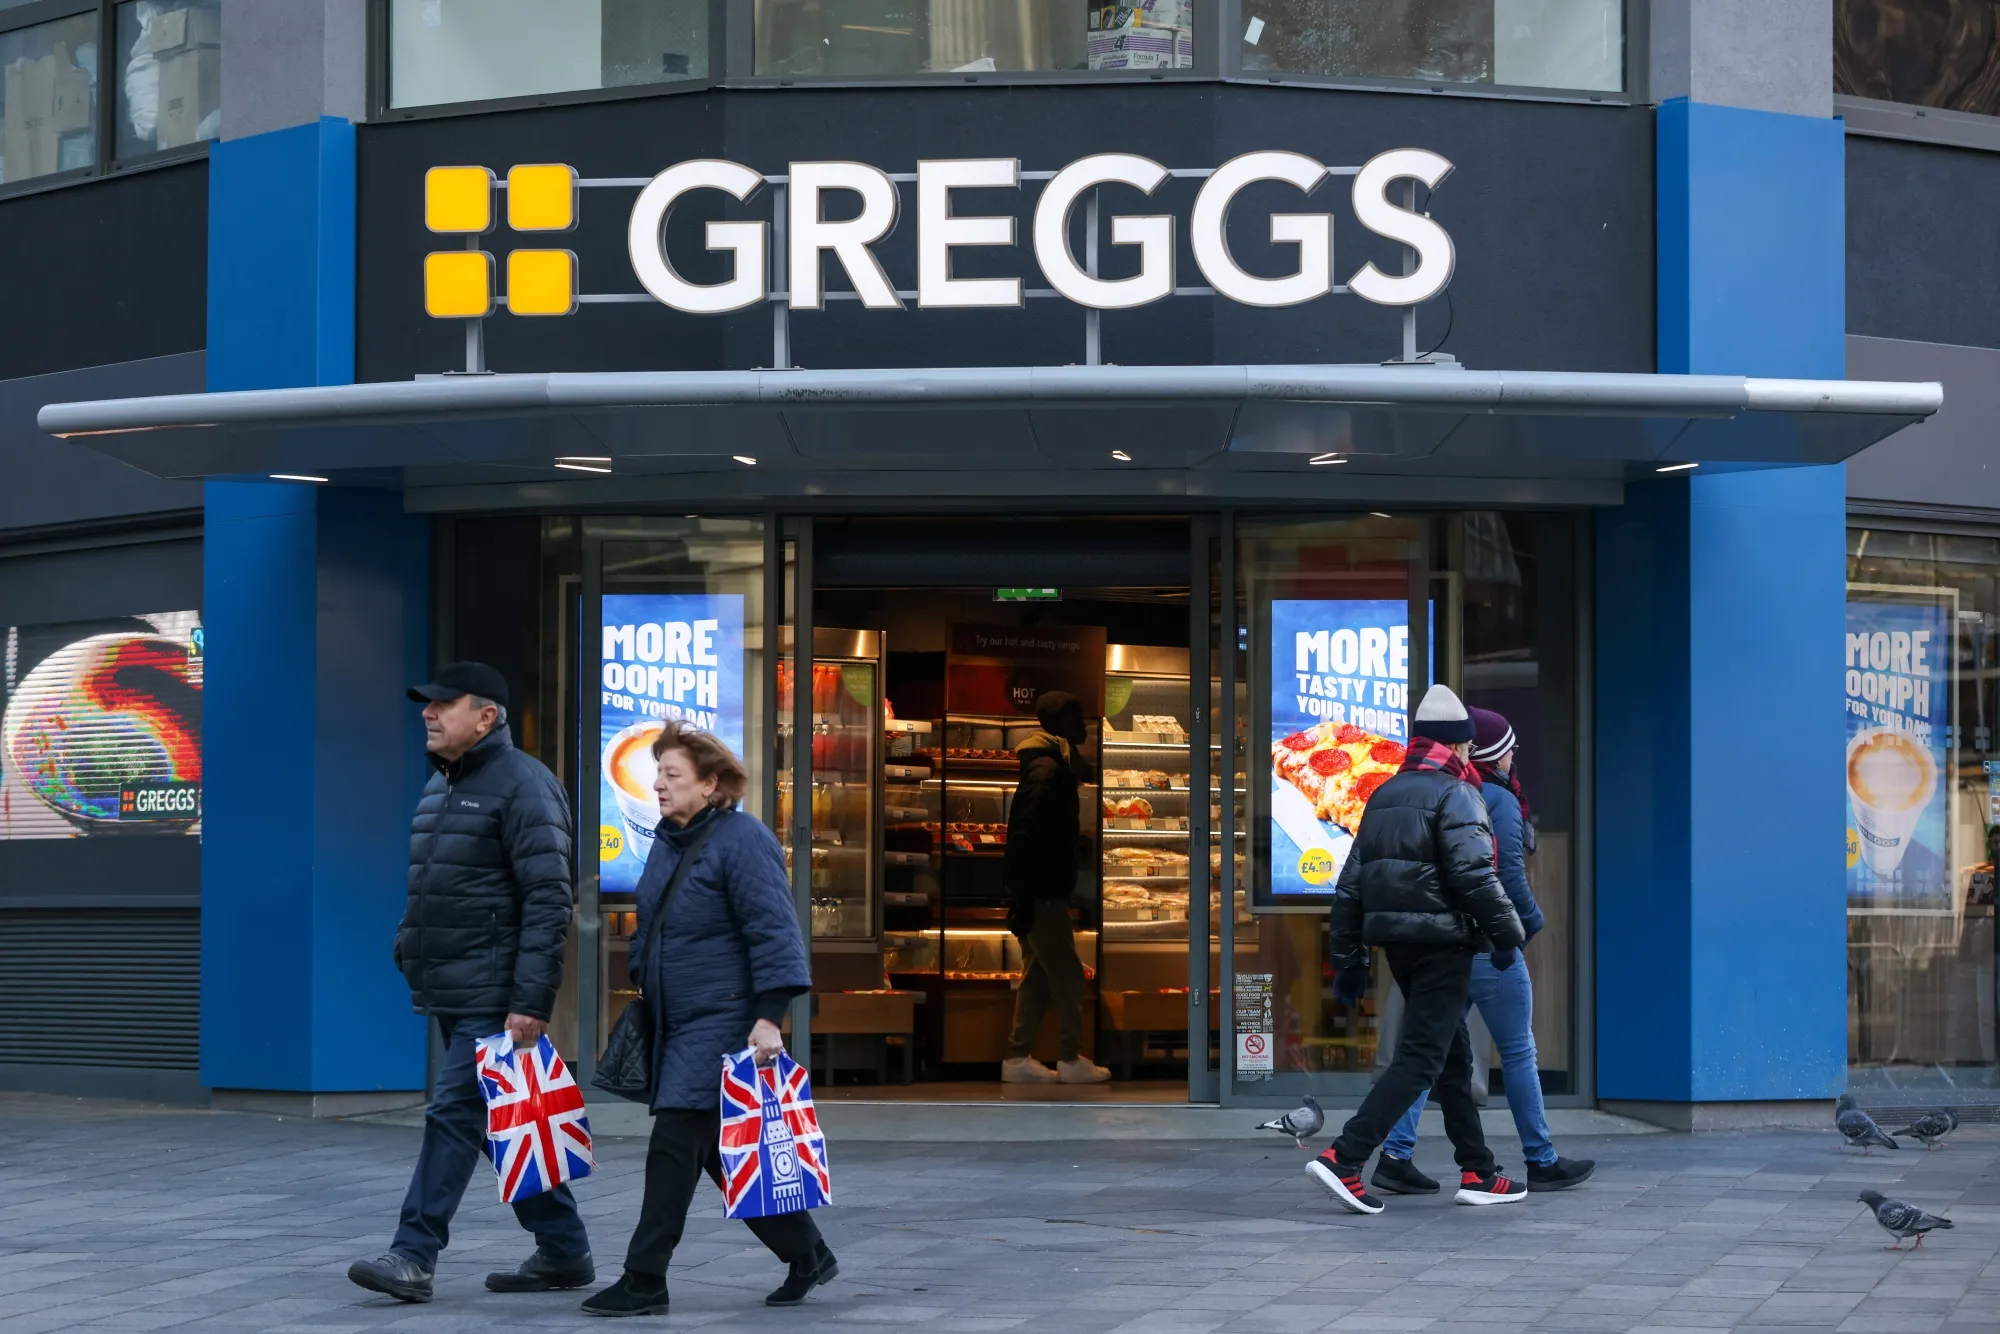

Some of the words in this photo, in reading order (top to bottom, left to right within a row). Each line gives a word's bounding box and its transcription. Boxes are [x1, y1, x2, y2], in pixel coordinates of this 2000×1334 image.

[627, 147, 1457, 314] GREGGS
[603, 619, 718, 667] MORE
[975, 634, 988, 647] Try
[1295, 625, 1408, 679] MORE
[1846, 630, 1930, 676] MORE
[602, 662, 718, 708] OOMPH
[1013, 687, 1036, 699] HOT
[1296, 672, 1368, 704] TASTY
[1846, 669, 1929, 717] OOMPH
[602, 691, 635, 712] FOR
[639, 698, 682, 721] YOUR
[1296, 695, 1346, 723] YOUR
[1846, 697, 1868, 719] FOR
[136, 788, 195, 812] GREGGS
